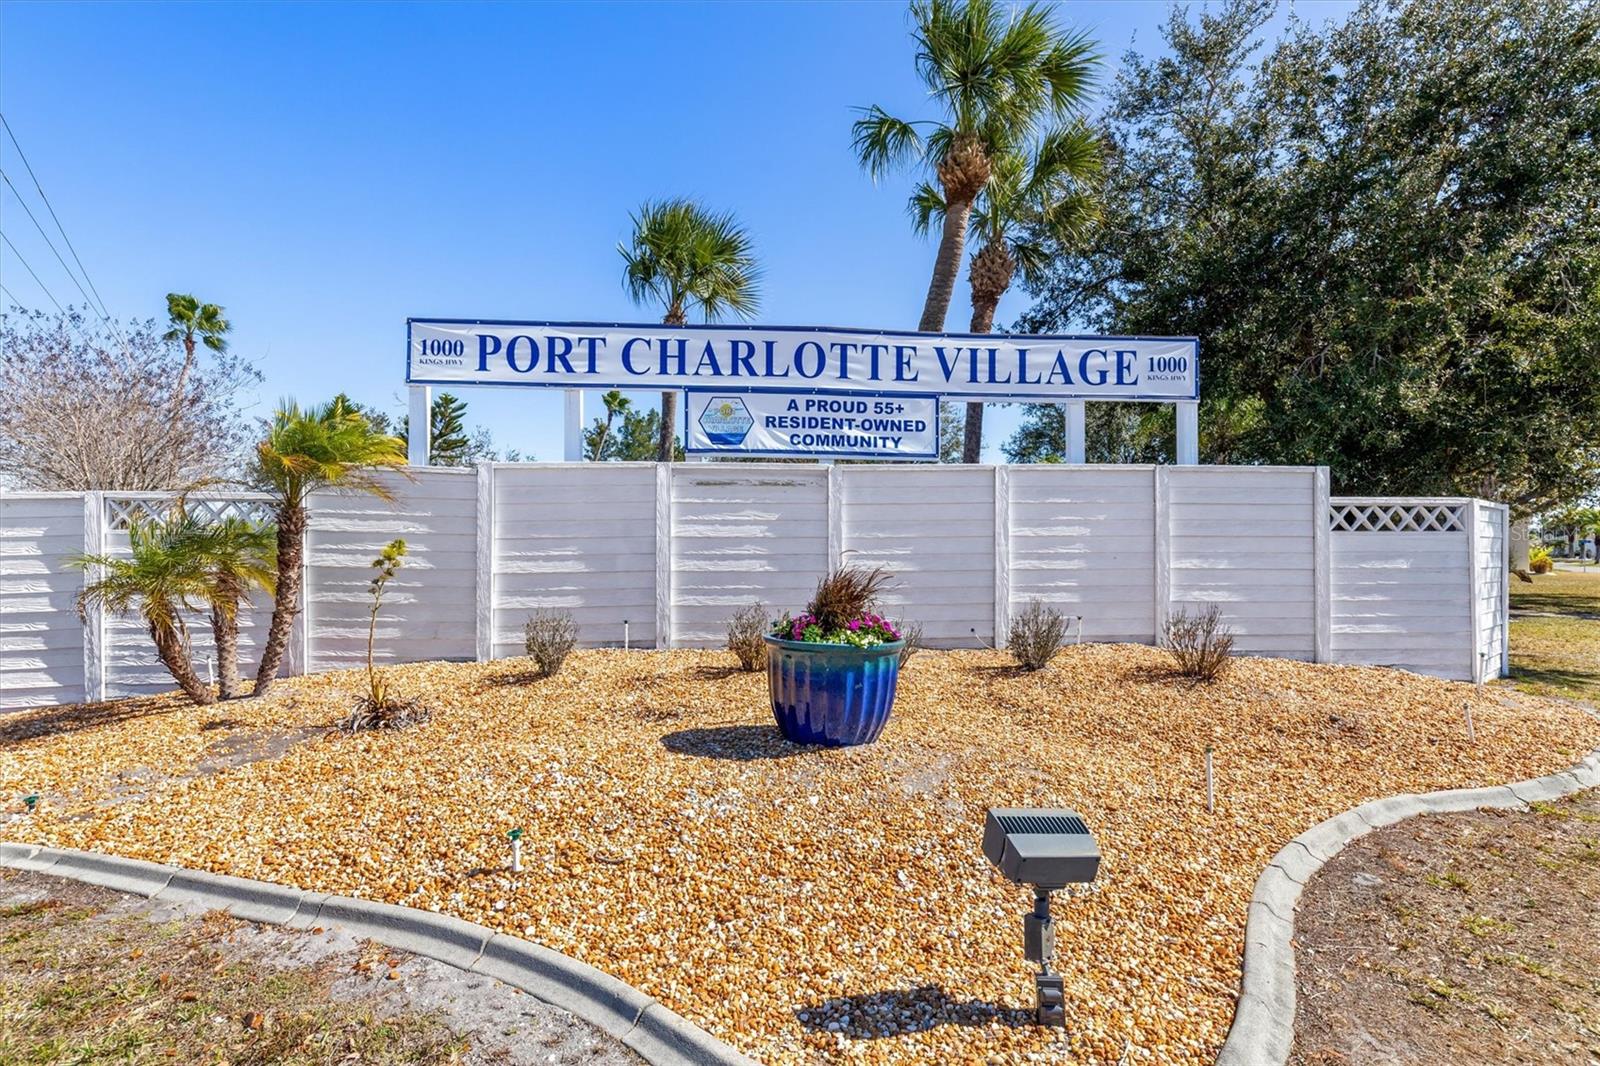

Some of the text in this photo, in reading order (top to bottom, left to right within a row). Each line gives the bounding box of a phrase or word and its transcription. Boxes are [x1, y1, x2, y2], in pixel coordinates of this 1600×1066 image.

[420, 338, 465, 357] 1000
[445, 358, 464, 366] HWY
[475, 334, 1140, 386] PORT CHARLOTTE VILLAGE
[1147, 356, 1188, 373] 1000
[786, 398, 905, 415] A PROUD 55+
[765, 415, 927, 433] RESIDENT-OWNED
[789, 433, 903, 449] COMMUNITY
